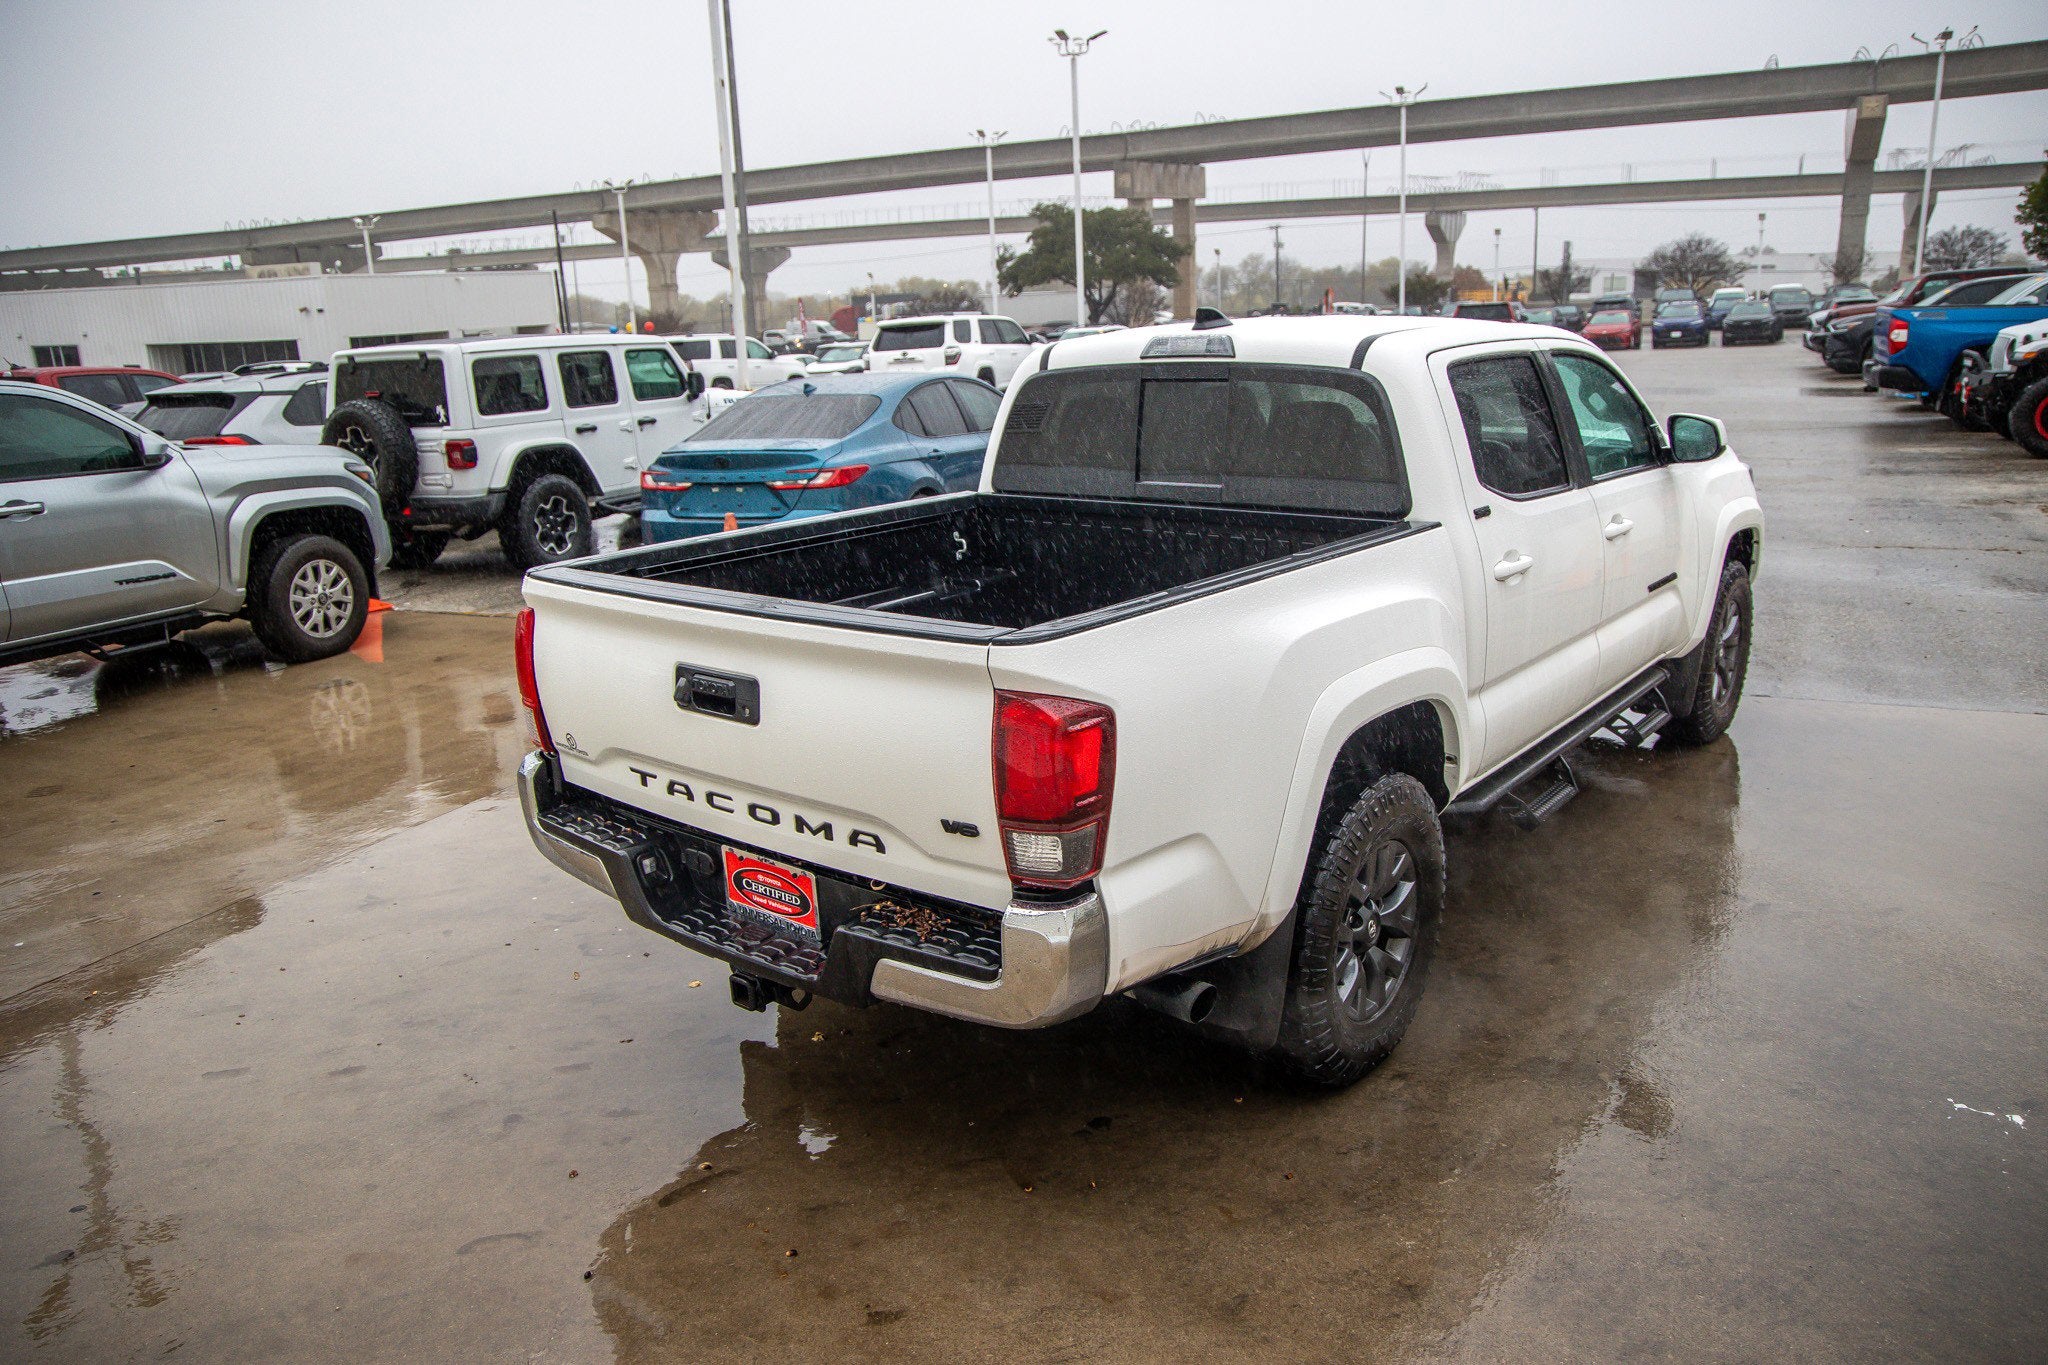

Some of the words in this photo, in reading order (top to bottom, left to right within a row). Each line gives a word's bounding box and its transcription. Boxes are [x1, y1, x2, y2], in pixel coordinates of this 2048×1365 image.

[629, 766, 886, 855] TACOMA
[940, 818, 980, 837] V6
[743, 878, 800, 905] CERTIFIED
[752, 895, 767, 904] Used
[768, 900, 792, 912] Vehicles
[785, 922, 817, 939] TOYOTA
